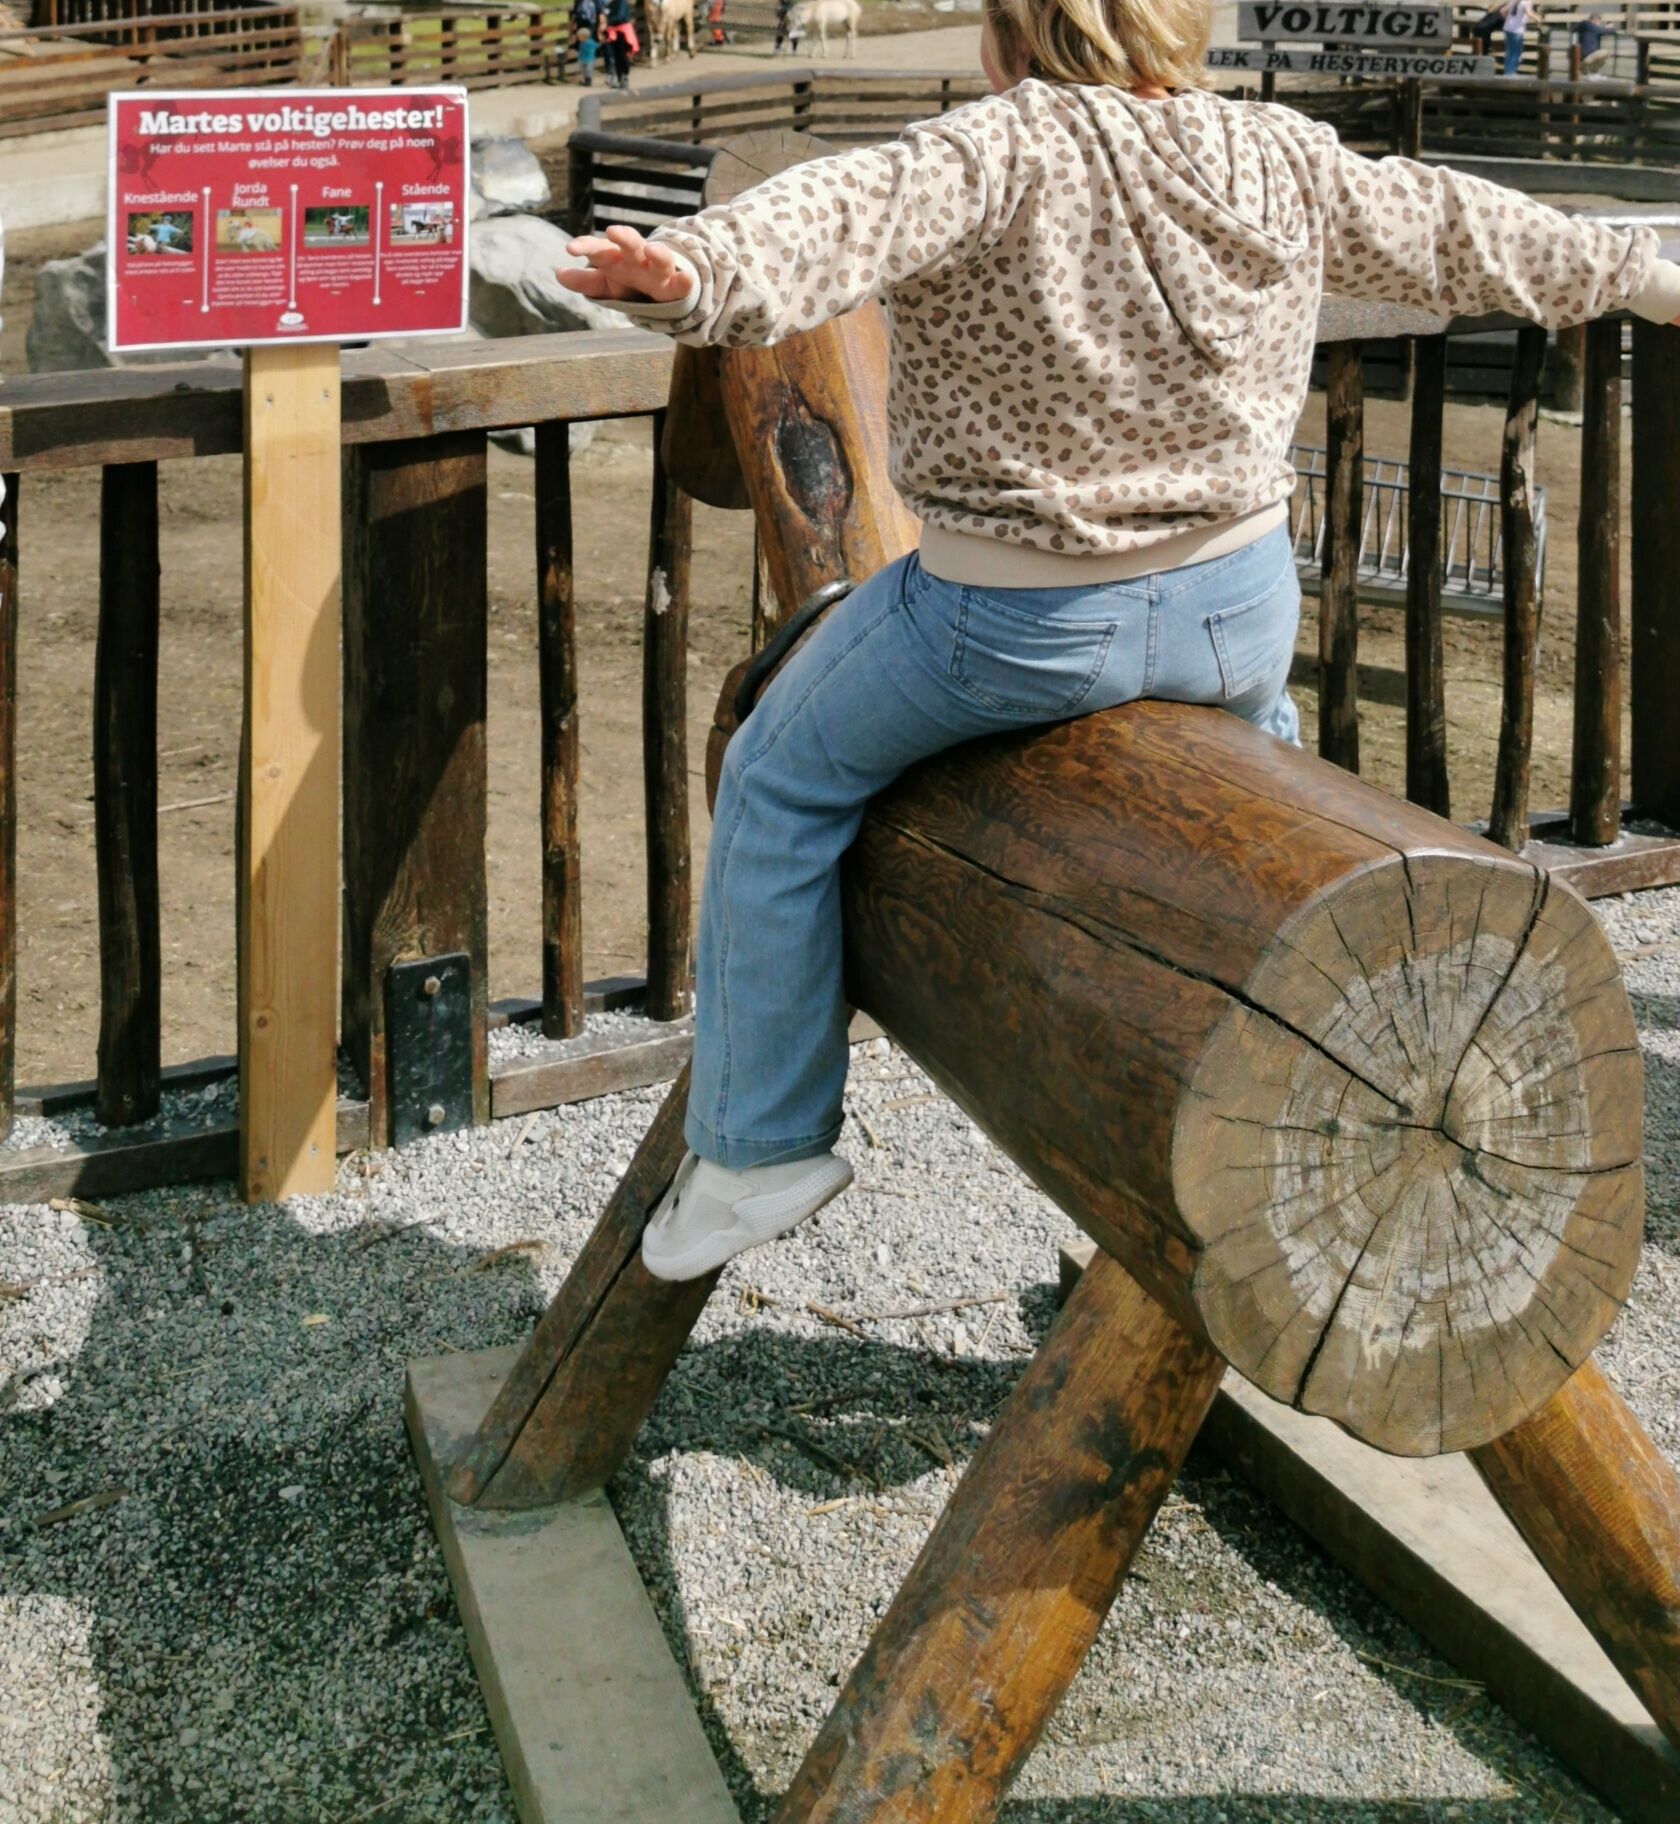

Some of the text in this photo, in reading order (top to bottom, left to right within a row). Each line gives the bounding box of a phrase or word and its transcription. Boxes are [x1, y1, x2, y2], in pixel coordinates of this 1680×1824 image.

[1253, 5, 1440, 38] VOLTIGE
[1207, 50, 1248, 67] LEK
[1309, 54, 1477, 75] HESTERYGGEN
[139, 106, 443, 136] Martes voltigehester!
[150, 136, 435, 154] Har du sett Marte stå på hesten? Prøv deg på noen
[248, 154, 340, 169] øvelser du også.
[234, 182, 267, 195] Jorda
[322, 186, 352, 198] Fane
[402, 182, 450, 196] Stående
[124, 191, 198, 204] Knestående
[232, 195, 270, 207] Rundt
